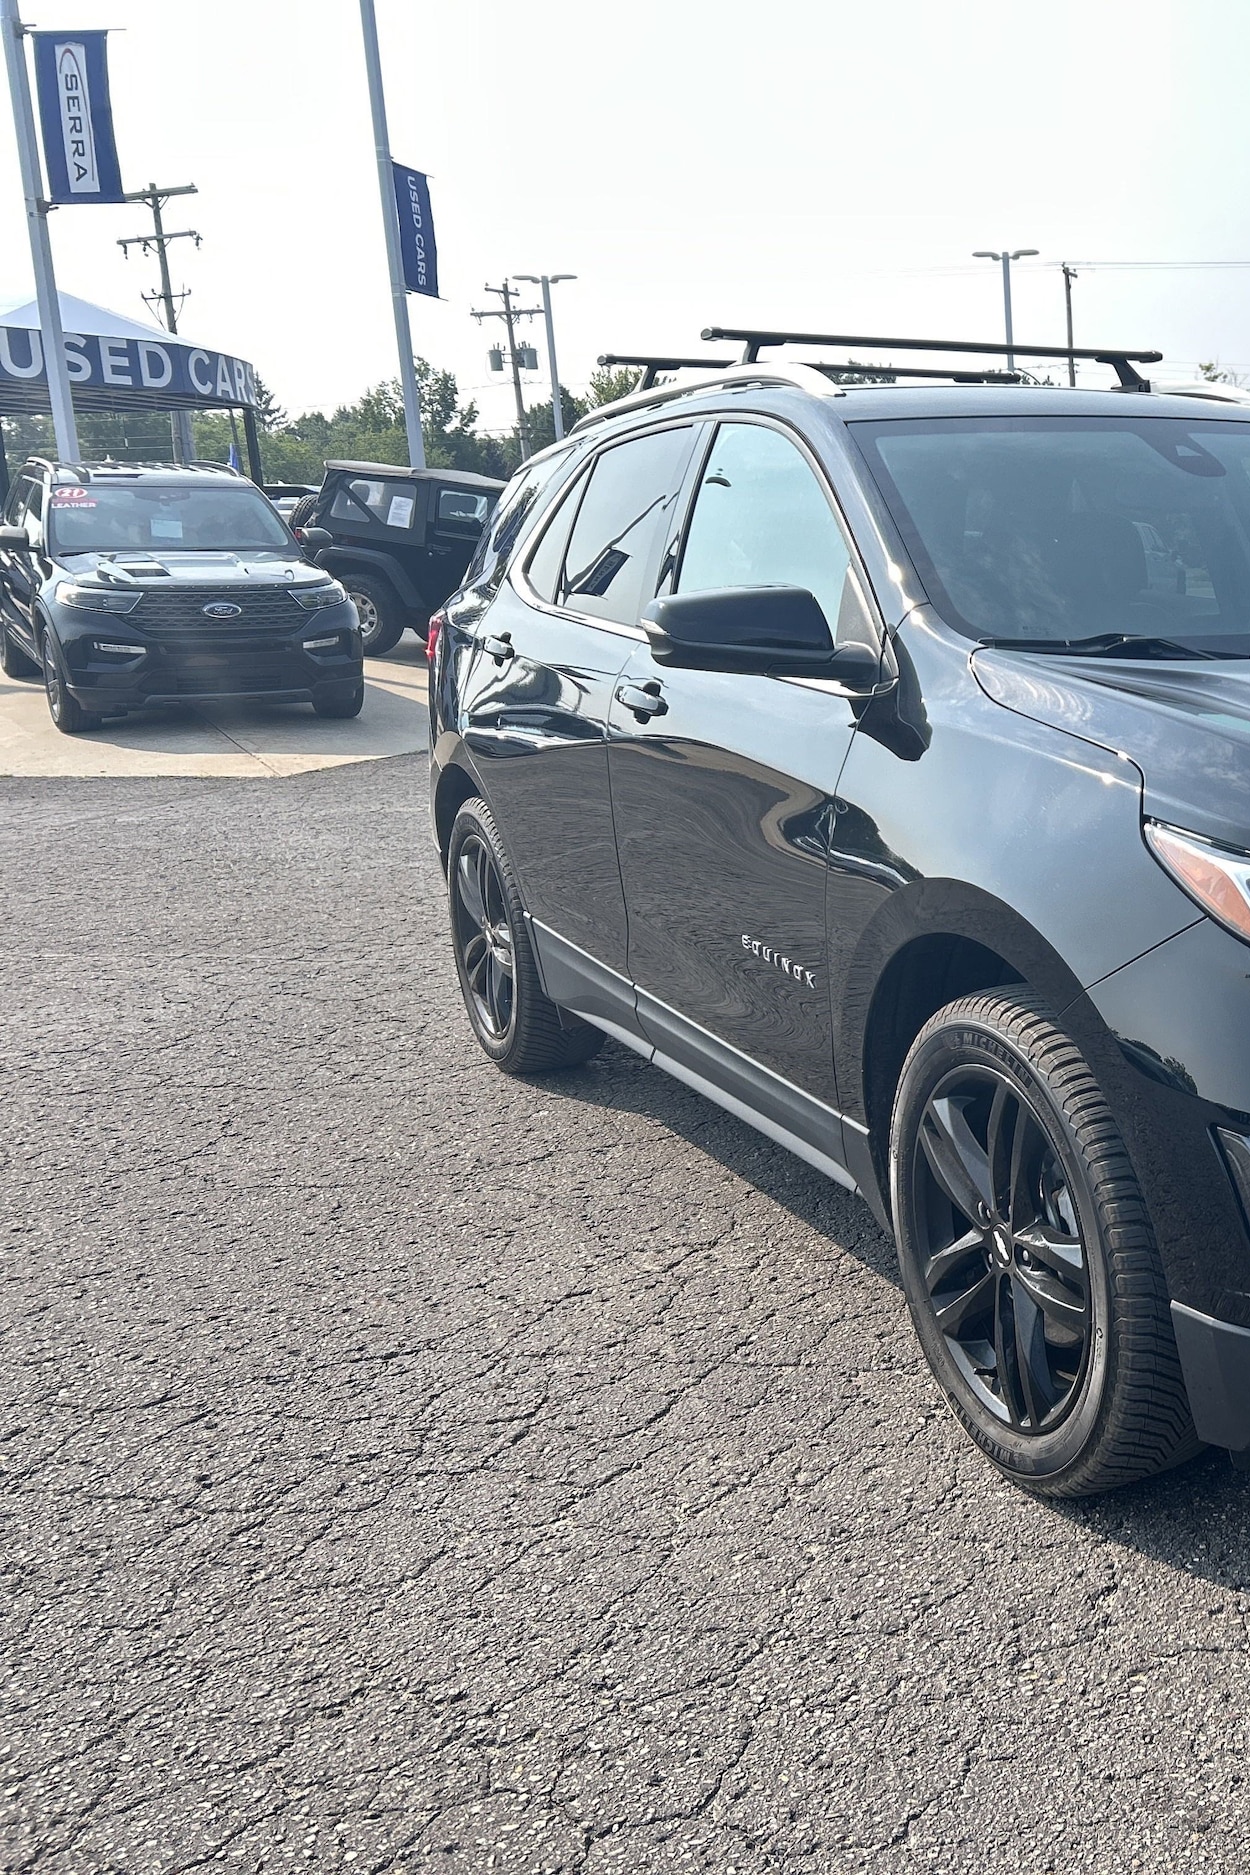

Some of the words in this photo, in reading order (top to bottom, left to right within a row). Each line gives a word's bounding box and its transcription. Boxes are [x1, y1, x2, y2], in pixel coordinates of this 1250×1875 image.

[65, 73, 88, 182] SERRA
[407, 175, 423, 229] USED
[415, 233, 427, 286] CARS
[0, 327, 173, 388] USED
[61, 488, 82, 497] 21
[213, 606, 233, 614] Ford
[741, 934, 816, 989] EQUINOX
[963, 1032, 1030, 1085] MICHELIN
